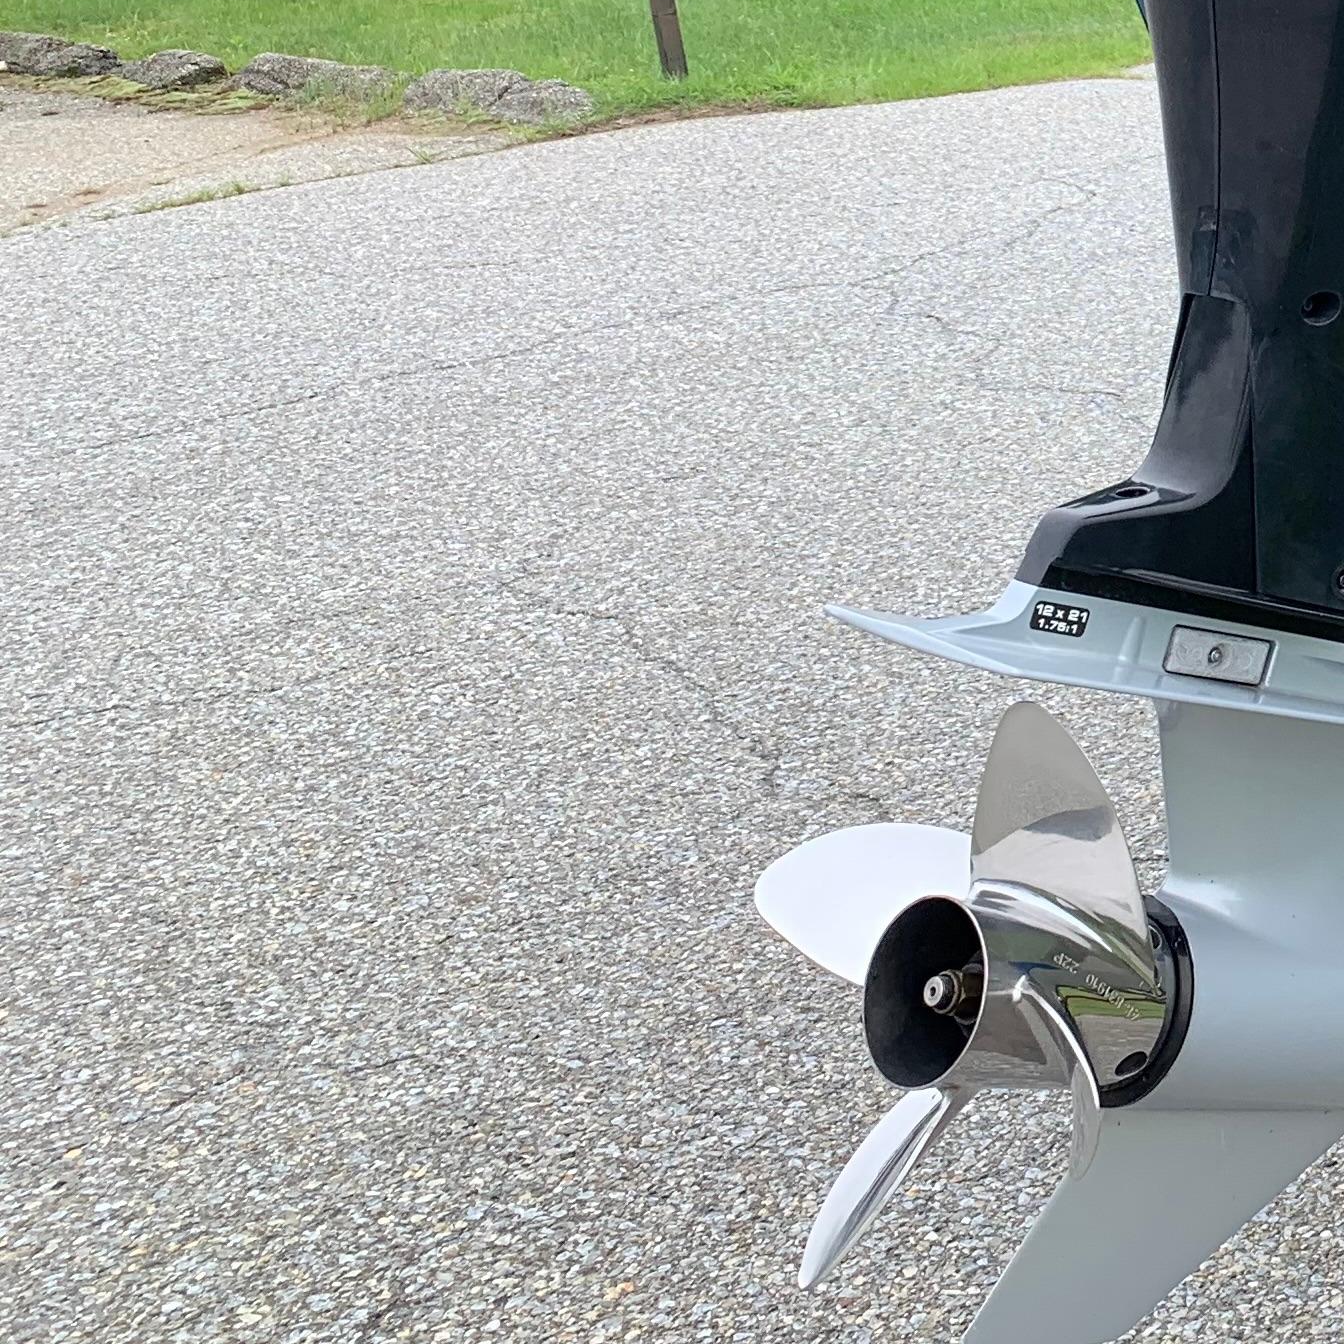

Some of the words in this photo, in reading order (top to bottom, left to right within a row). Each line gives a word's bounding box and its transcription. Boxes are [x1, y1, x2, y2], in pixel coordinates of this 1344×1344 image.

[1036, 603, 1055, 617] 12
[1055, 609, 1066, 619] x
[1067, 609, 1089, 623] 21
[1037, 618, 1079, 634] 1.75:1
[1053, 952, 1080, 974] 22P
